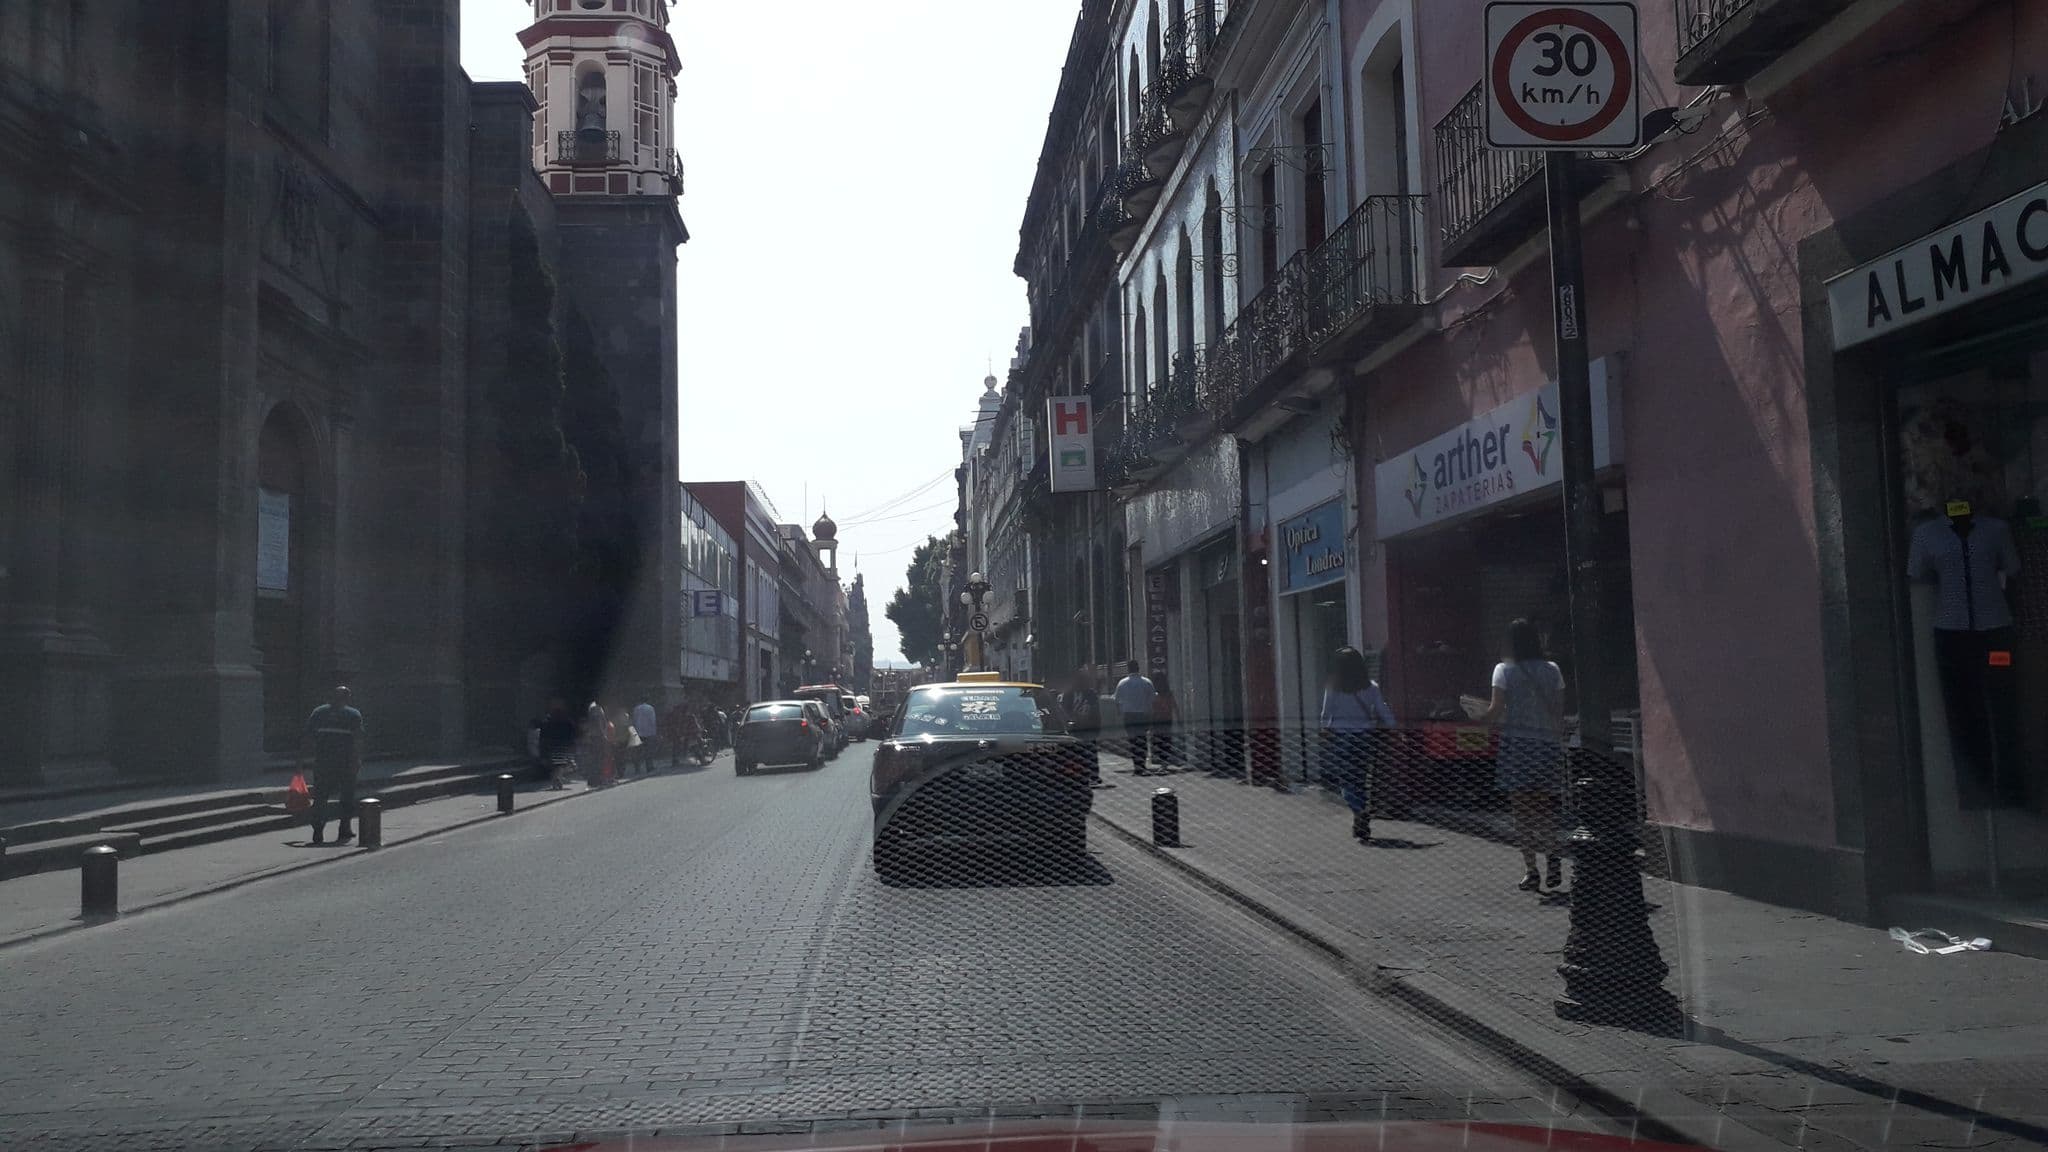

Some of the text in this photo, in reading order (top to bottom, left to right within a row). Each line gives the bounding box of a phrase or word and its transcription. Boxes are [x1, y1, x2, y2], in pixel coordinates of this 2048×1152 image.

[1531, 32, 1598, 77] 30
[1521, 82, 1600, 105] km/h
[1055, 401, 1088, 436] H
[1433, 423, 1511, 491] arther
[1434, 469, 1514, 515] ZAPATERIAS
[1305, 547, 1345, 576] Londres
[697, 591, 718, 613] E
